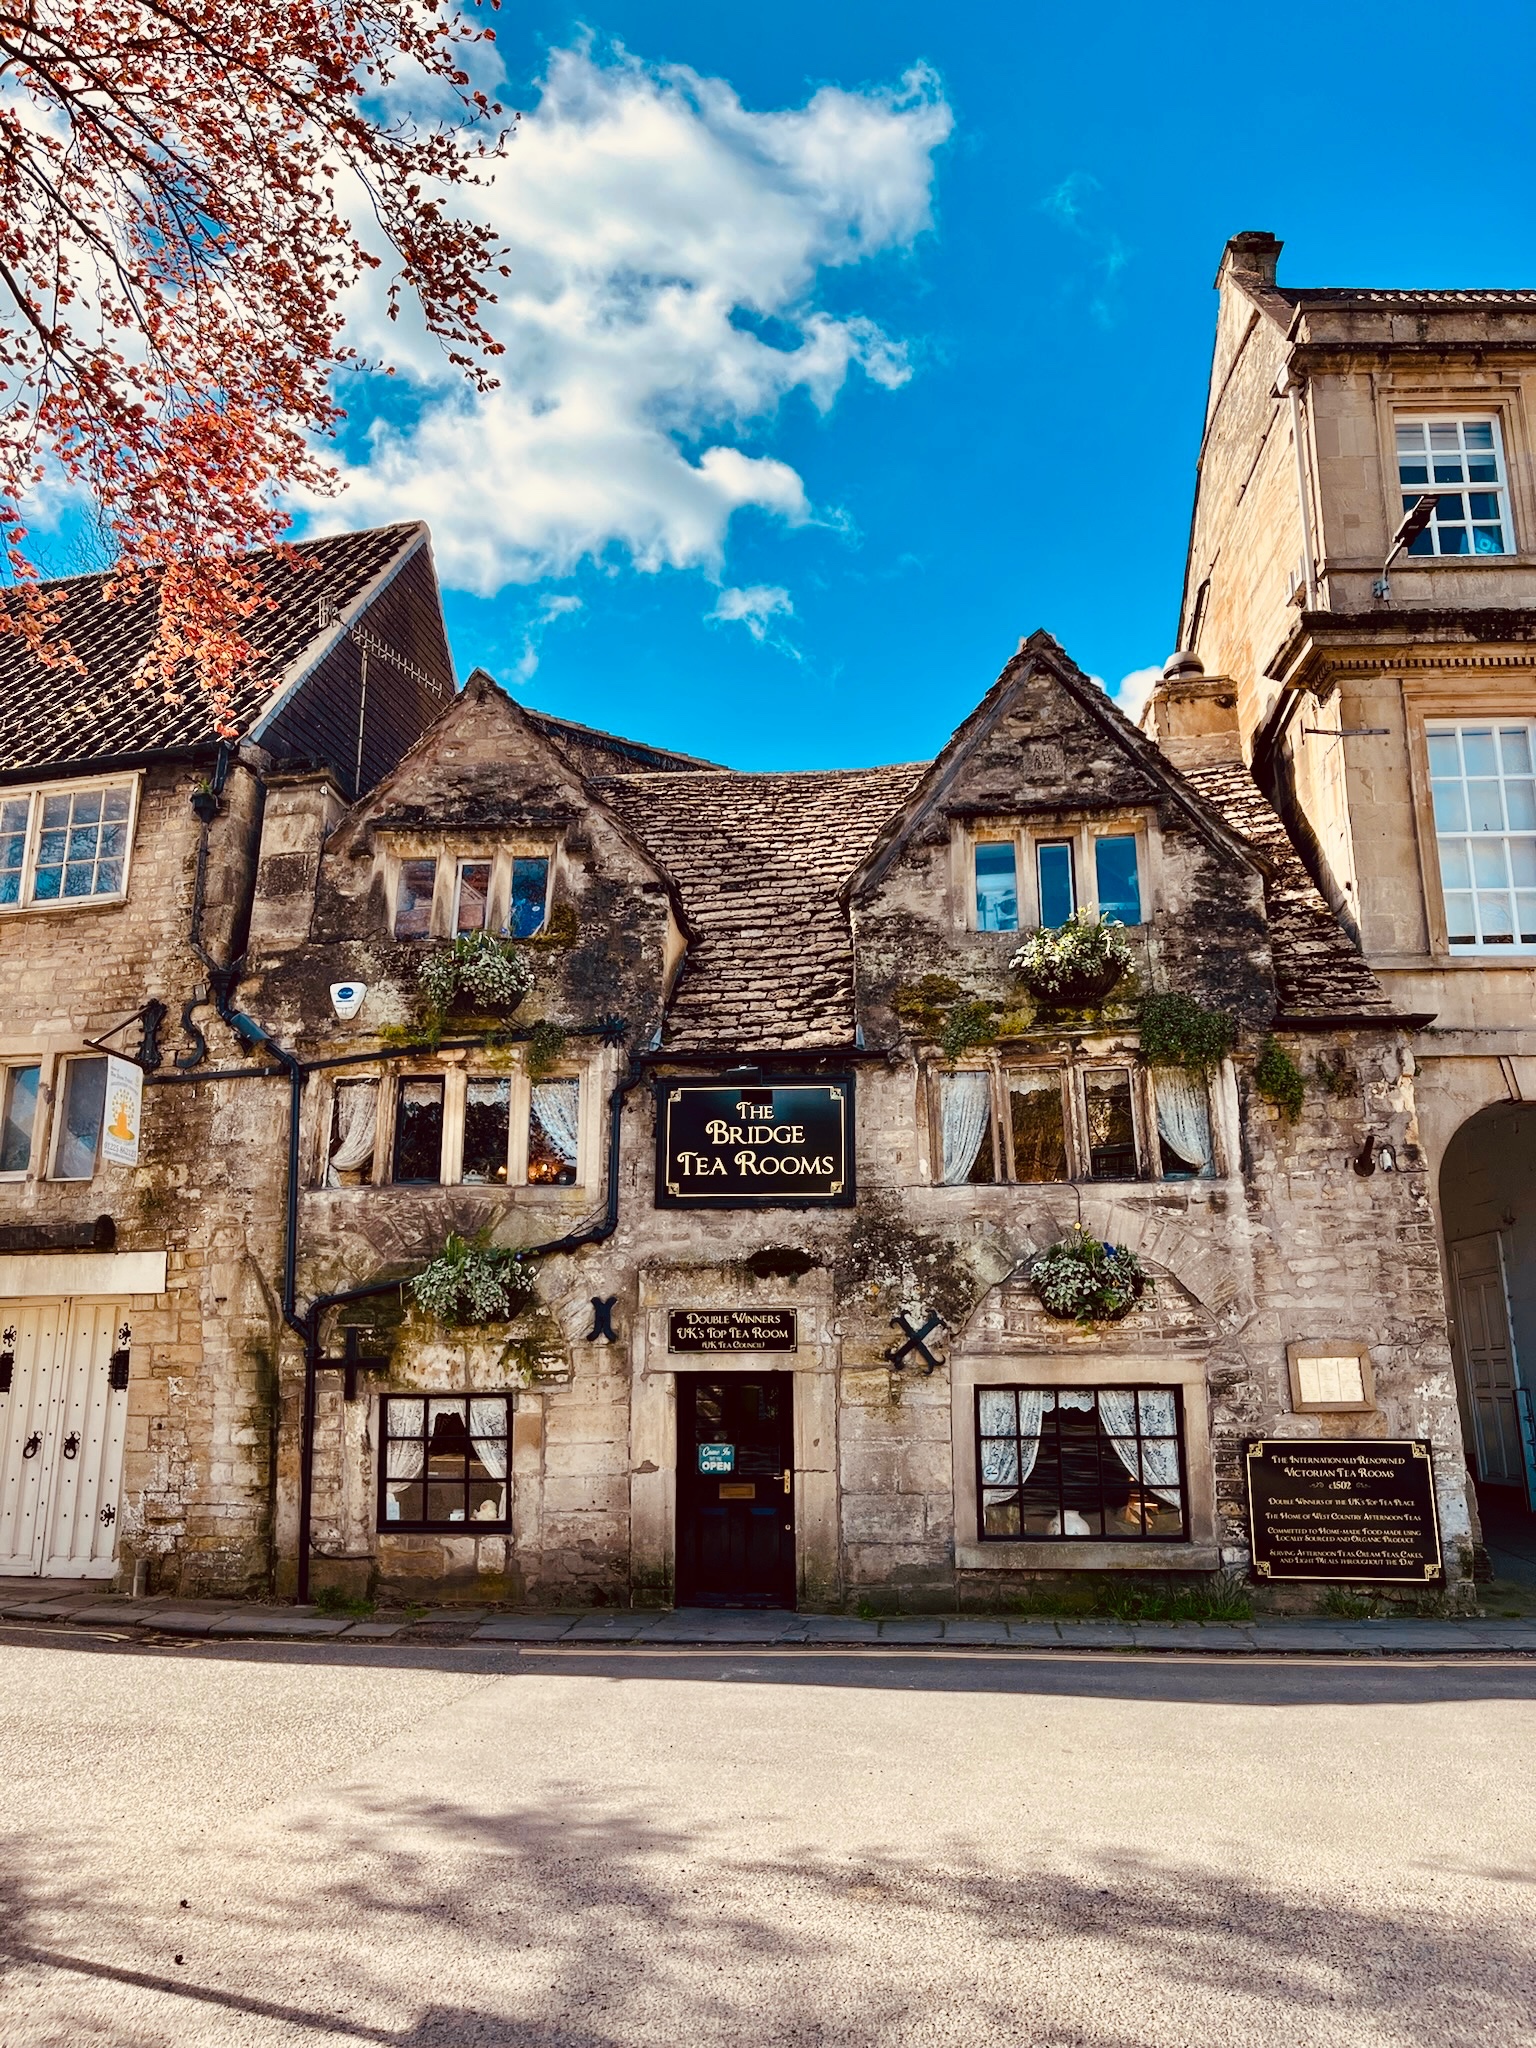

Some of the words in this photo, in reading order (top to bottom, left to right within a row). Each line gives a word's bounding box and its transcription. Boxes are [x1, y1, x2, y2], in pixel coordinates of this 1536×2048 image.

[736, 1102, 774, 1119] THE
[705, 1120, 805, 1144] BRIDGE
[677, 1151, 728, 1175] TEA
[734, 1150, 834, 1175] ROOMS
[686, 1313, 730, 1324] DOUBLE
[732, 1312, 780, 1324] WINNERS
[707, 1327, 726, 1338] TOP
[729, 1327, 749, 1338] TEA
[752, 1327, 788, 1338] ROOM
[718, 1341, 732, 1349] TEA
[1271, 1455, 1288, 1464] THE
[1289, 1455, 1357, 1464] INTERNATIONALLY
[1356, 1455, 1405, 1464] RENOWNED
[702, 1462, 731, 1471] OPEN
[1284, 1467, 1335, 1477] VICTORIAN
[1336, 1468, 1356, 1477] TEA
[1358, 1468, 1394, 1478] ROOMS
[1268, 1497, 1293, 1505] DOUBLE
[1280, 1512, 1302, 1520] HOME
[1312, 1512, 1330, 1520] WEST
[1275, 1534, 1303, 1542] LOCALLY
[1351, 1535, 1381, 1543] ORGANIC
[1297, 1549, 1336, 1557] AFTERNOON
